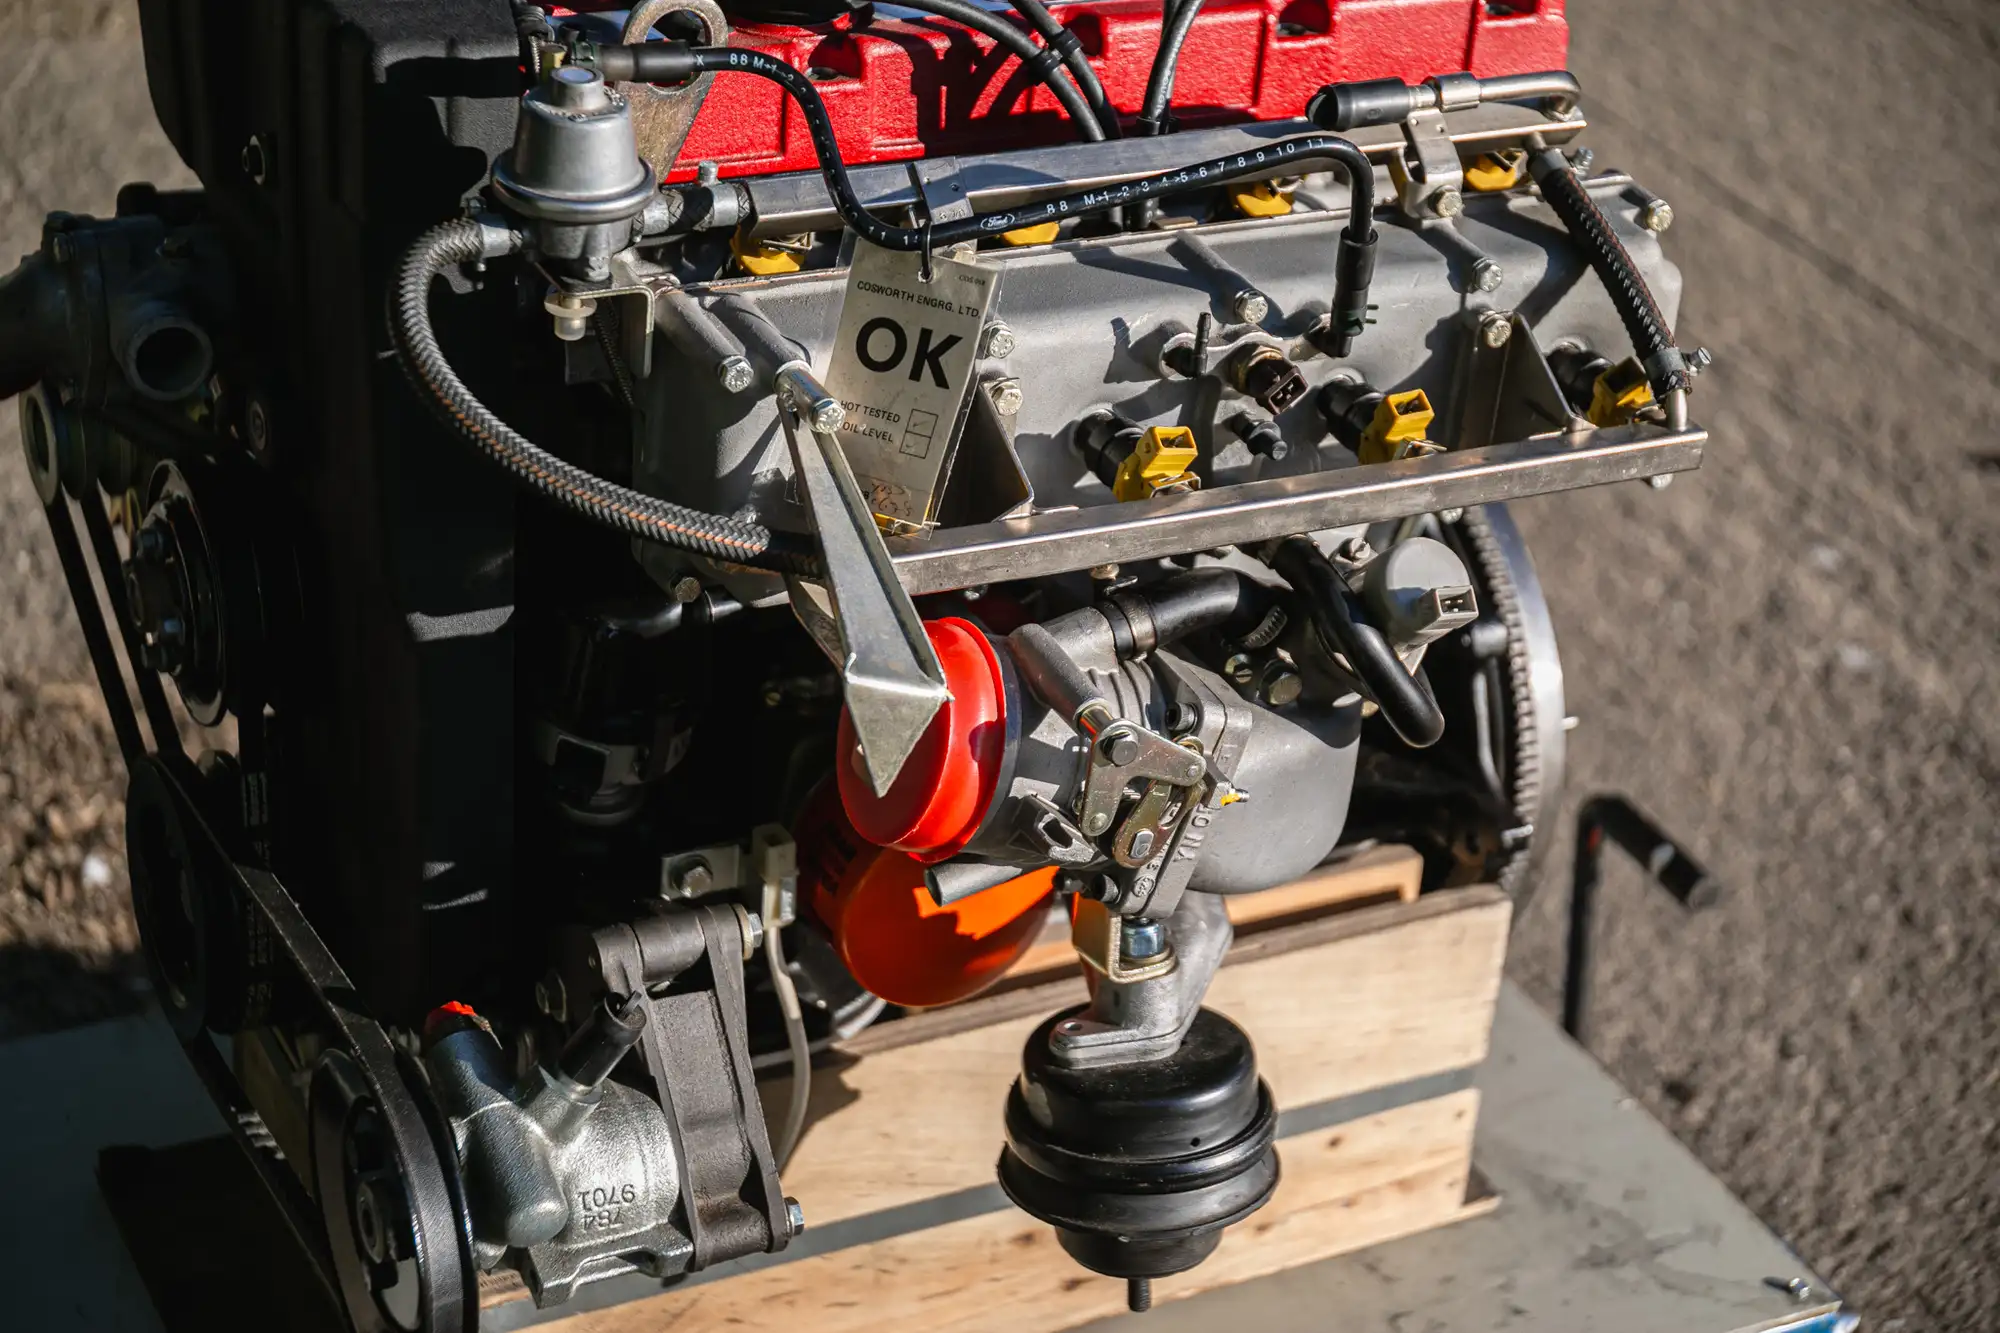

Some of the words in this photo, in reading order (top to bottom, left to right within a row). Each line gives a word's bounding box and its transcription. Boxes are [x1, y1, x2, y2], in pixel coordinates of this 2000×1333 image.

[730, 53, 748, 66] 88
[1218, 161, 1226, 172] 7
[1237, 156, 1246, 167] 8
[1256, 151, 1265, 162] 9
[1276, 143, 1295, 156] 10
[857, 280, 915, 303] COSWORTH
[916, 294, 955, 313] ENGRG.
[958, 305, 981, 320] LTD.
[856, 316, 963, 389] OK
[863, 405, 901, 423] TESTED
[842, 421, 859, 434] OIL
[862, 427, 893, 444] LEVEL
[578, 1183, 636, 1212] 9701
